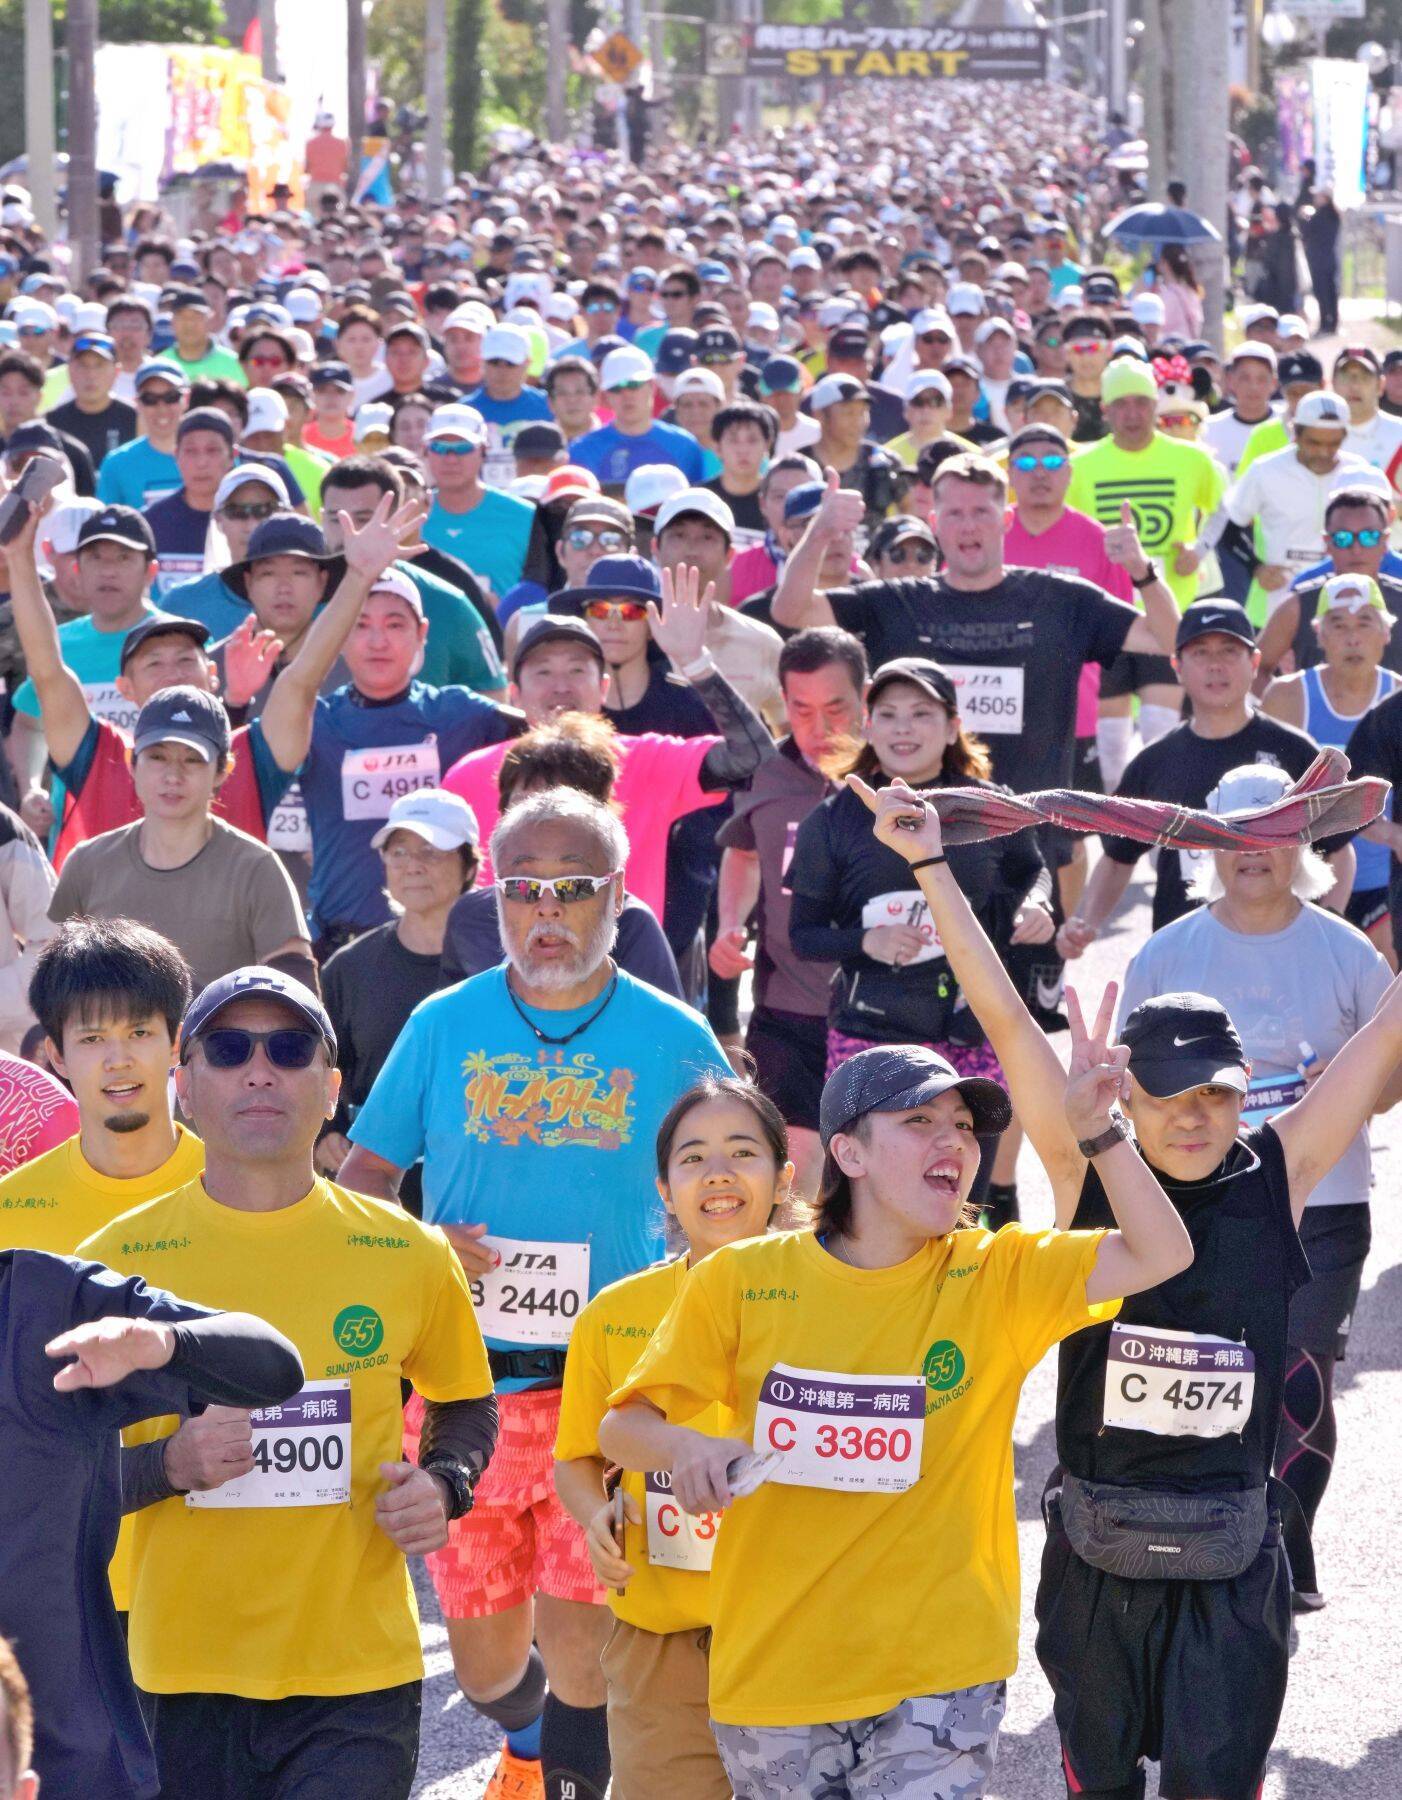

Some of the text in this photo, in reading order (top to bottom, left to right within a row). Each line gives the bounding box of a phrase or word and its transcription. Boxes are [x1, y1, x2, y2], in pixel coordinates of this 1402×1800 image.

[786, 49, 970, 76] START
[968, 675, 1002, 686] JTA
[965, 697, 1017, 715] 4505
[383, 754, 417, 767] JTA
[353, 775, 434, 800] C 4915
[505, 1252, 557, 1270] JTA
[499, 1284, 580, 1318] 2440
[339, 1316, 378, 1349] 55
[325, 1353, 389, 1376] SUNJYA GO GO
[926, 1348, 957, 1385] 55
[1149, 1343, 1245, 1367] 沖縄第一病院
[798, 1386, 911, 1412] 沖縄第一病院
[951, 1385, 965, 1400] GO
[1120, 1373, 1244, 1411] C 4574
[768, 1417, 912, 1462] C 3360
[252, 1434, 344, 1474] 4900
[657, 1504, 724, 1540] C 3
